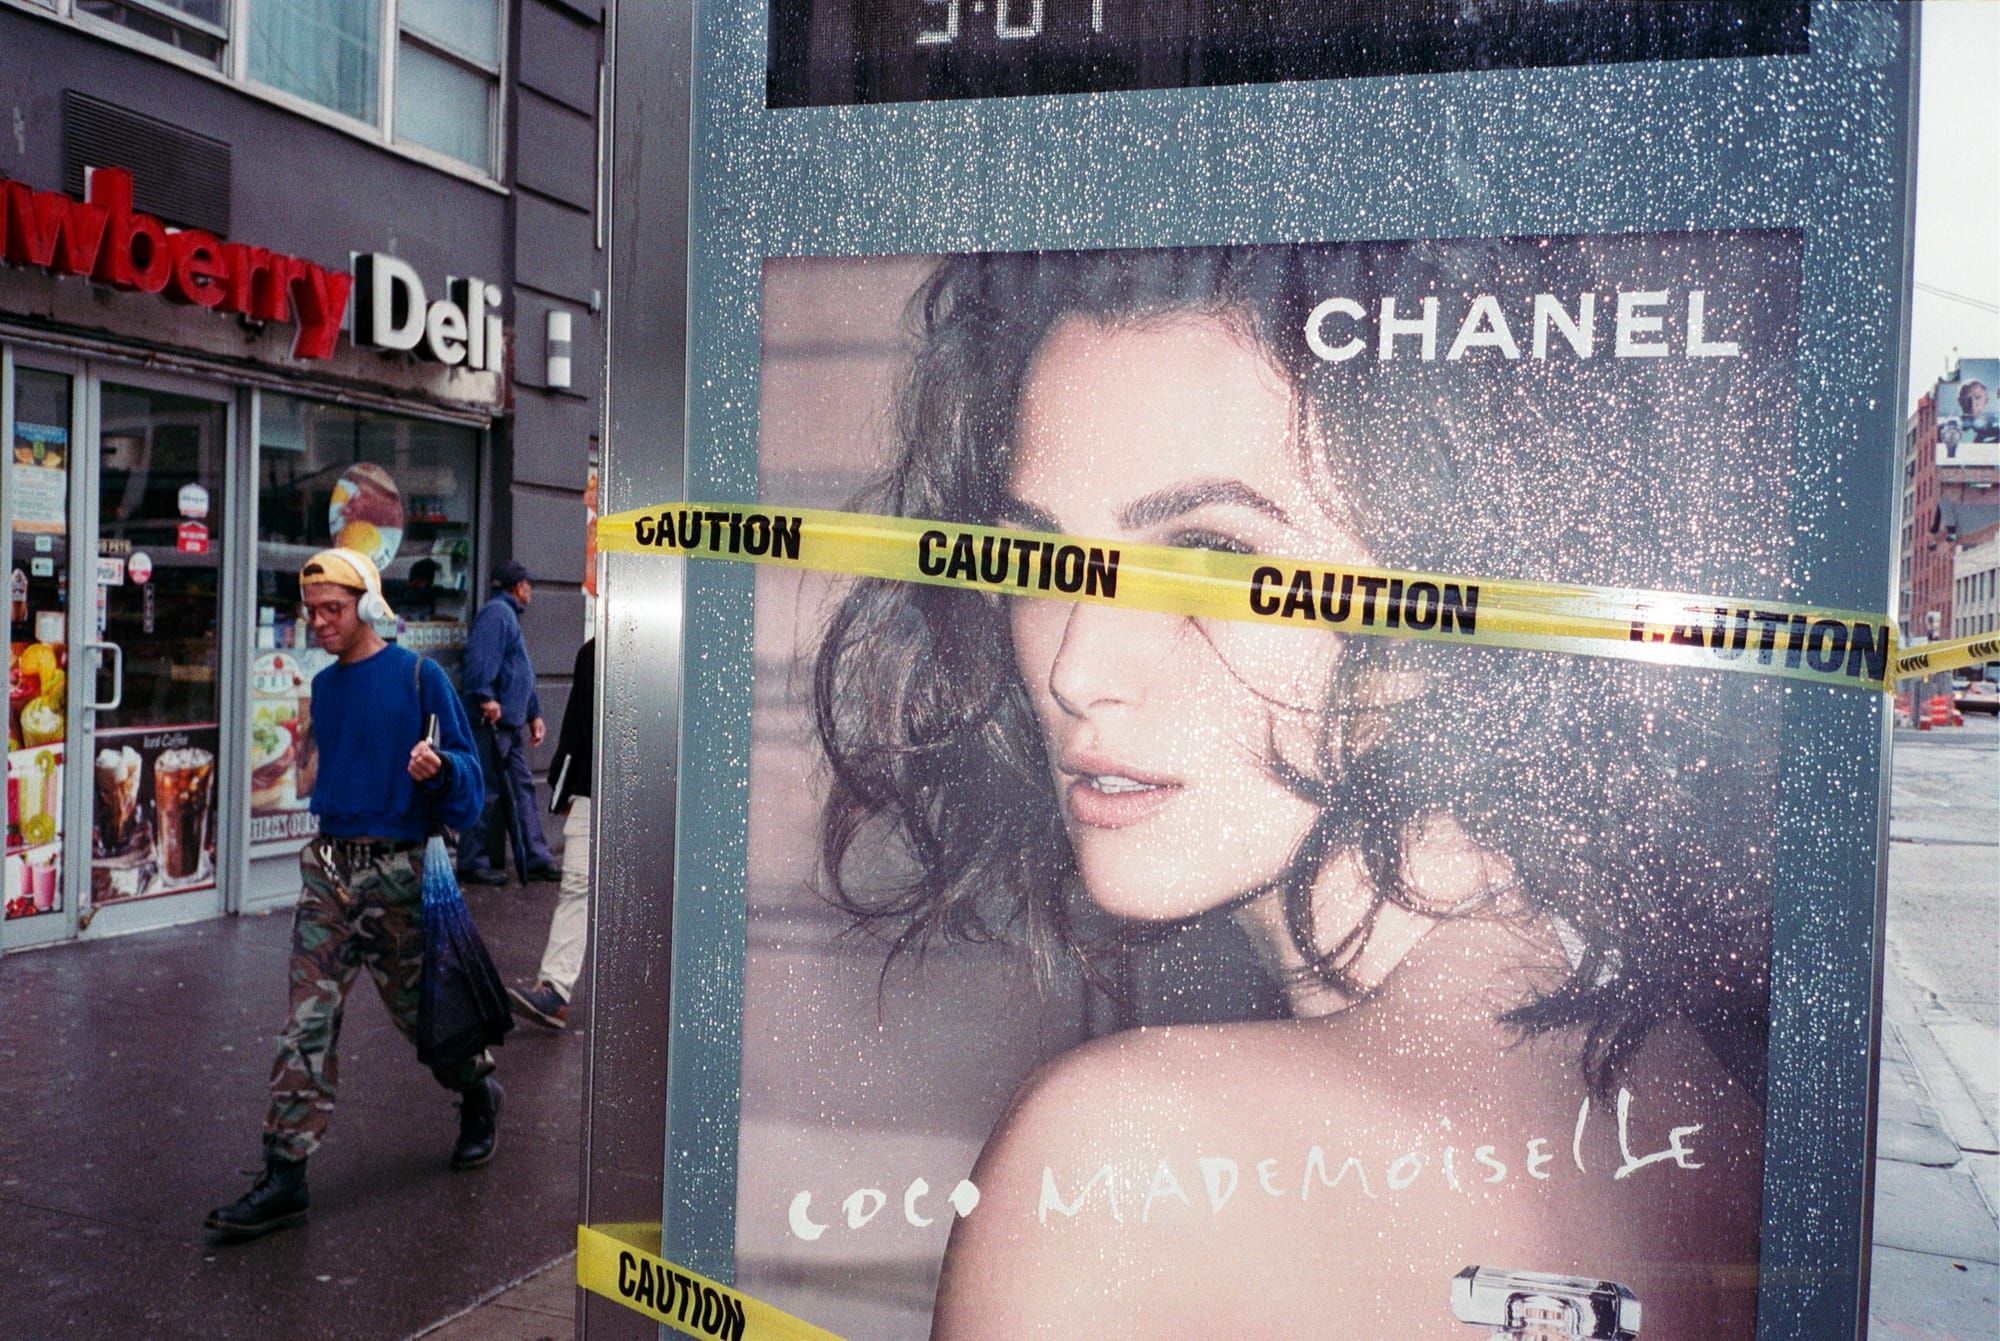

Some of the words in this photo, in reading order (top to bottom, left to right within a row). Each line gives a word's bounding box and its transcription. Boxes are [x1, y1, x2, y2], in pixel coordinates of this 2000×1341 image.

[0, 166, 352, 360] wberry
[358, 252, 502, 374] Deli
[1304, 290, 1740, 362] CHANEL
[635, 510, 802, 560] CAUTION
[918, 530, 1121, 598] CAUTION
[1248, 565, 1480, 635] CAUTION
[143, 734, 160, 749] Iced
[161, 732, 189, 749] Coffee
[788, 1179, 980, 1241] COCO
[617, 1250, 746, 1341] CAUTION
